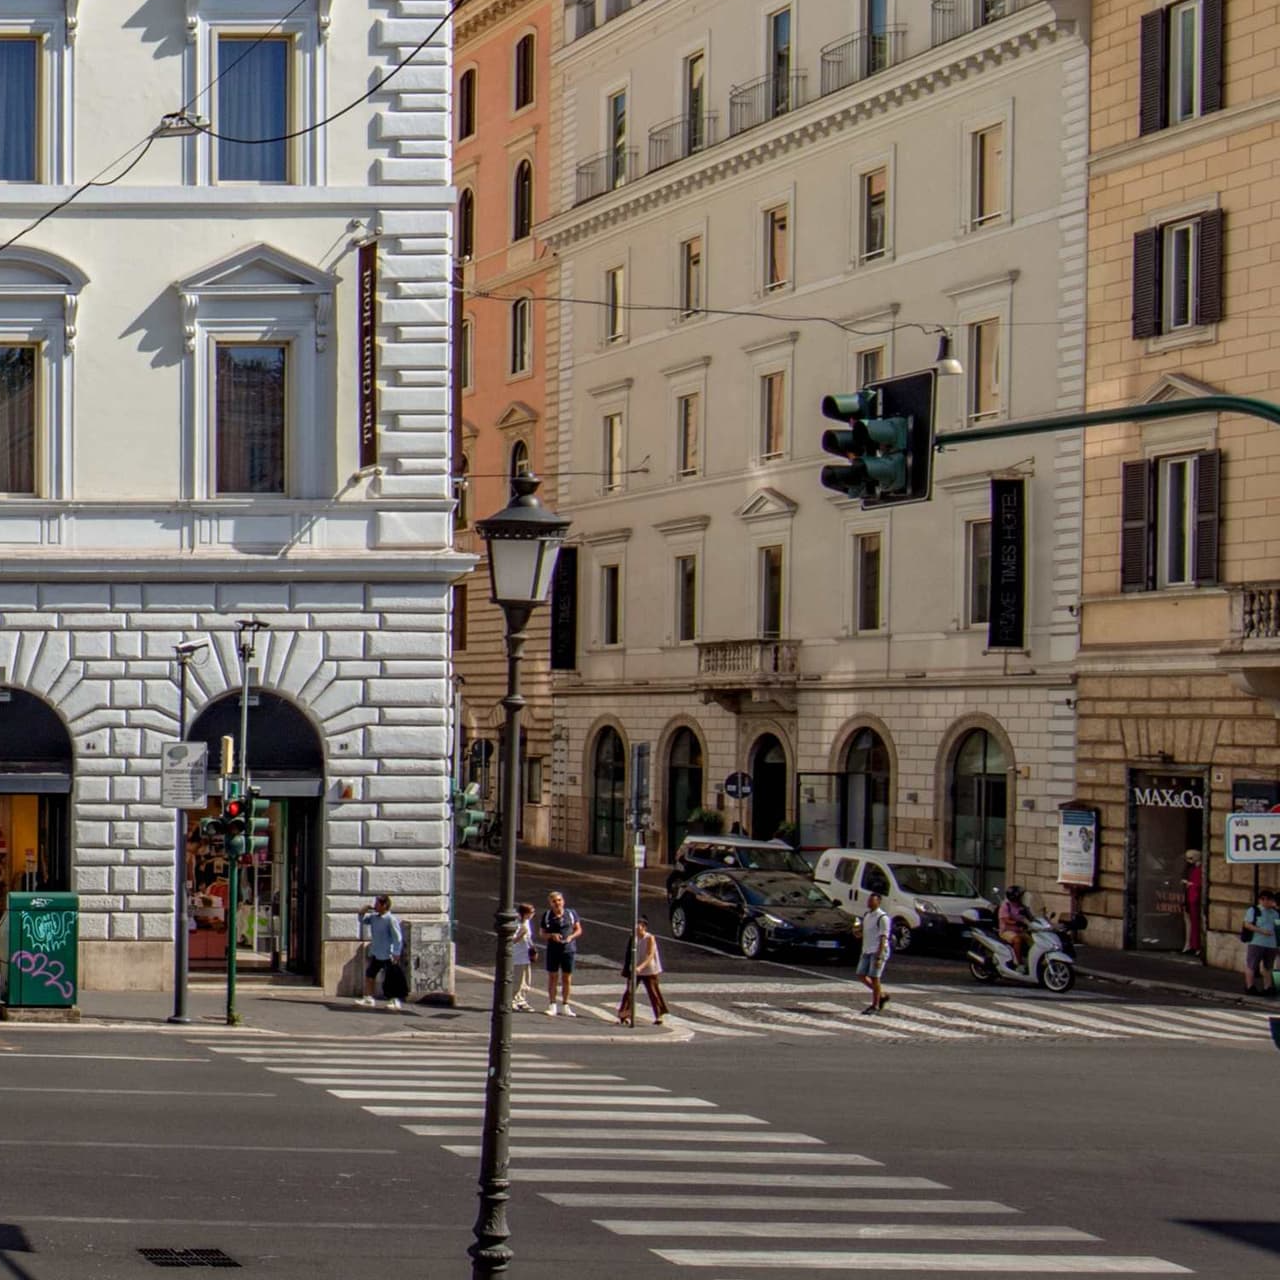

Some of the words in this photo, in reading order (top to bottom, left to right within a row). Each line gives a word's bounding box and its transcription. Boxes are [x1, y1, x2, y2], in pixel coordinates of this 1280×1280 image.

[362, 268, 372, 327] Hotel
[362, 335, 372, 395] Glam
[362, 402, 372, 445] The
[1001, 487, 1017, 540] HOTEL
[1001, 544, 1017, 585] TIMES
[1234, 818, 1249, 827] via
